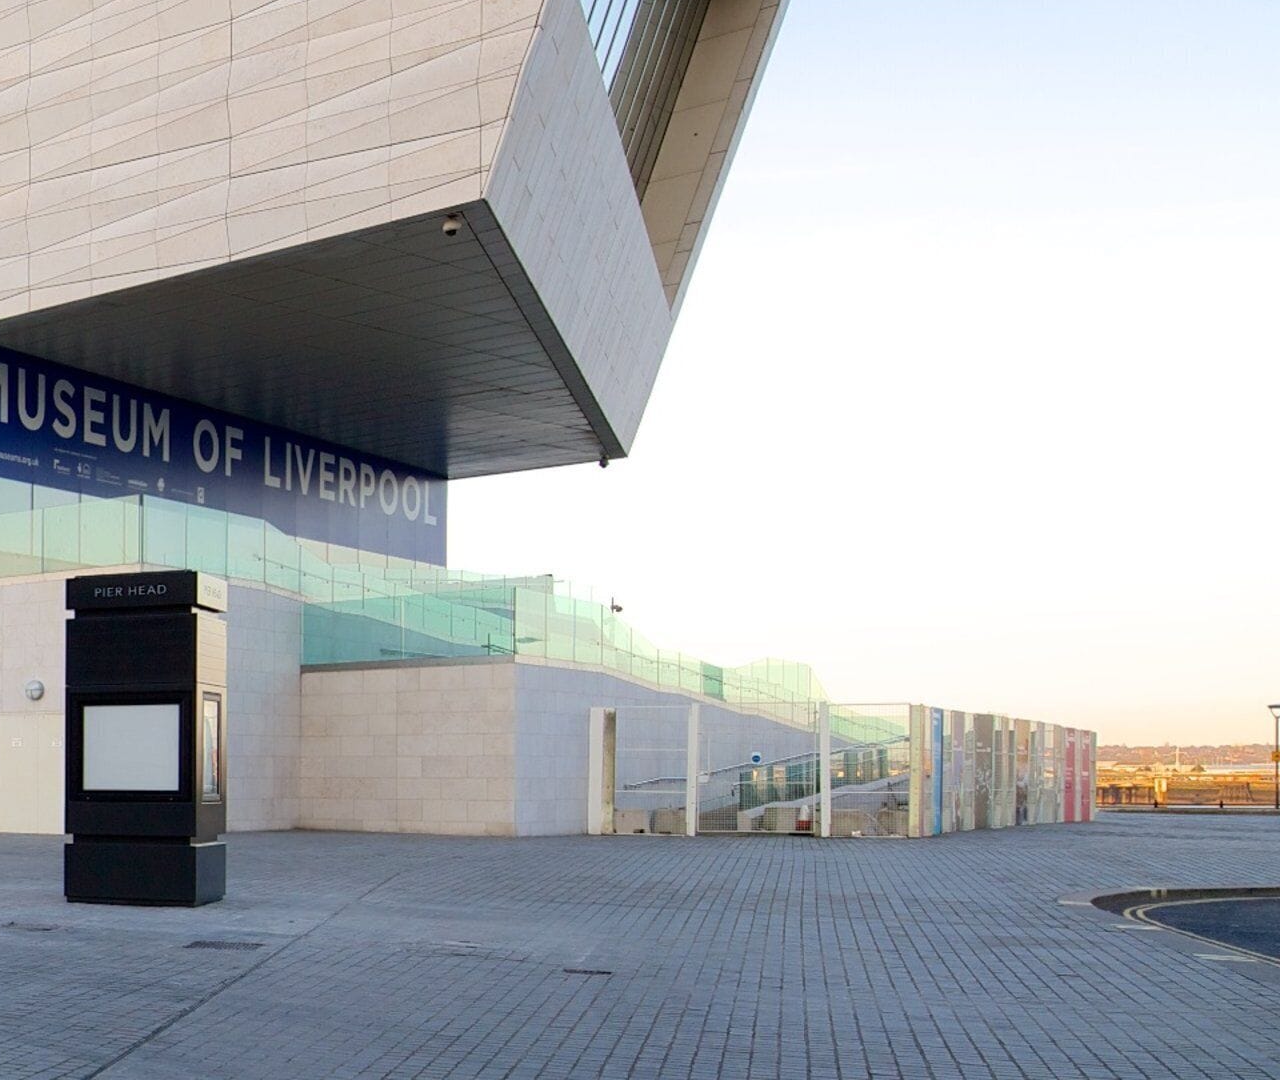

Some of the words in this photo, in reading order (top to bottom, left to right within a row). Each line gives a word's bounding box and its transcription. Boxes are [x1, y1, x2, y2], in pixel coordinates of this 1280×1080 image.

[192, 418, 244, 477] OF
[263, 436, 438, 526] LIVERPOOL
[94, 587, 123, 598] PIER
[128, 584, 167, 596] HEAD
